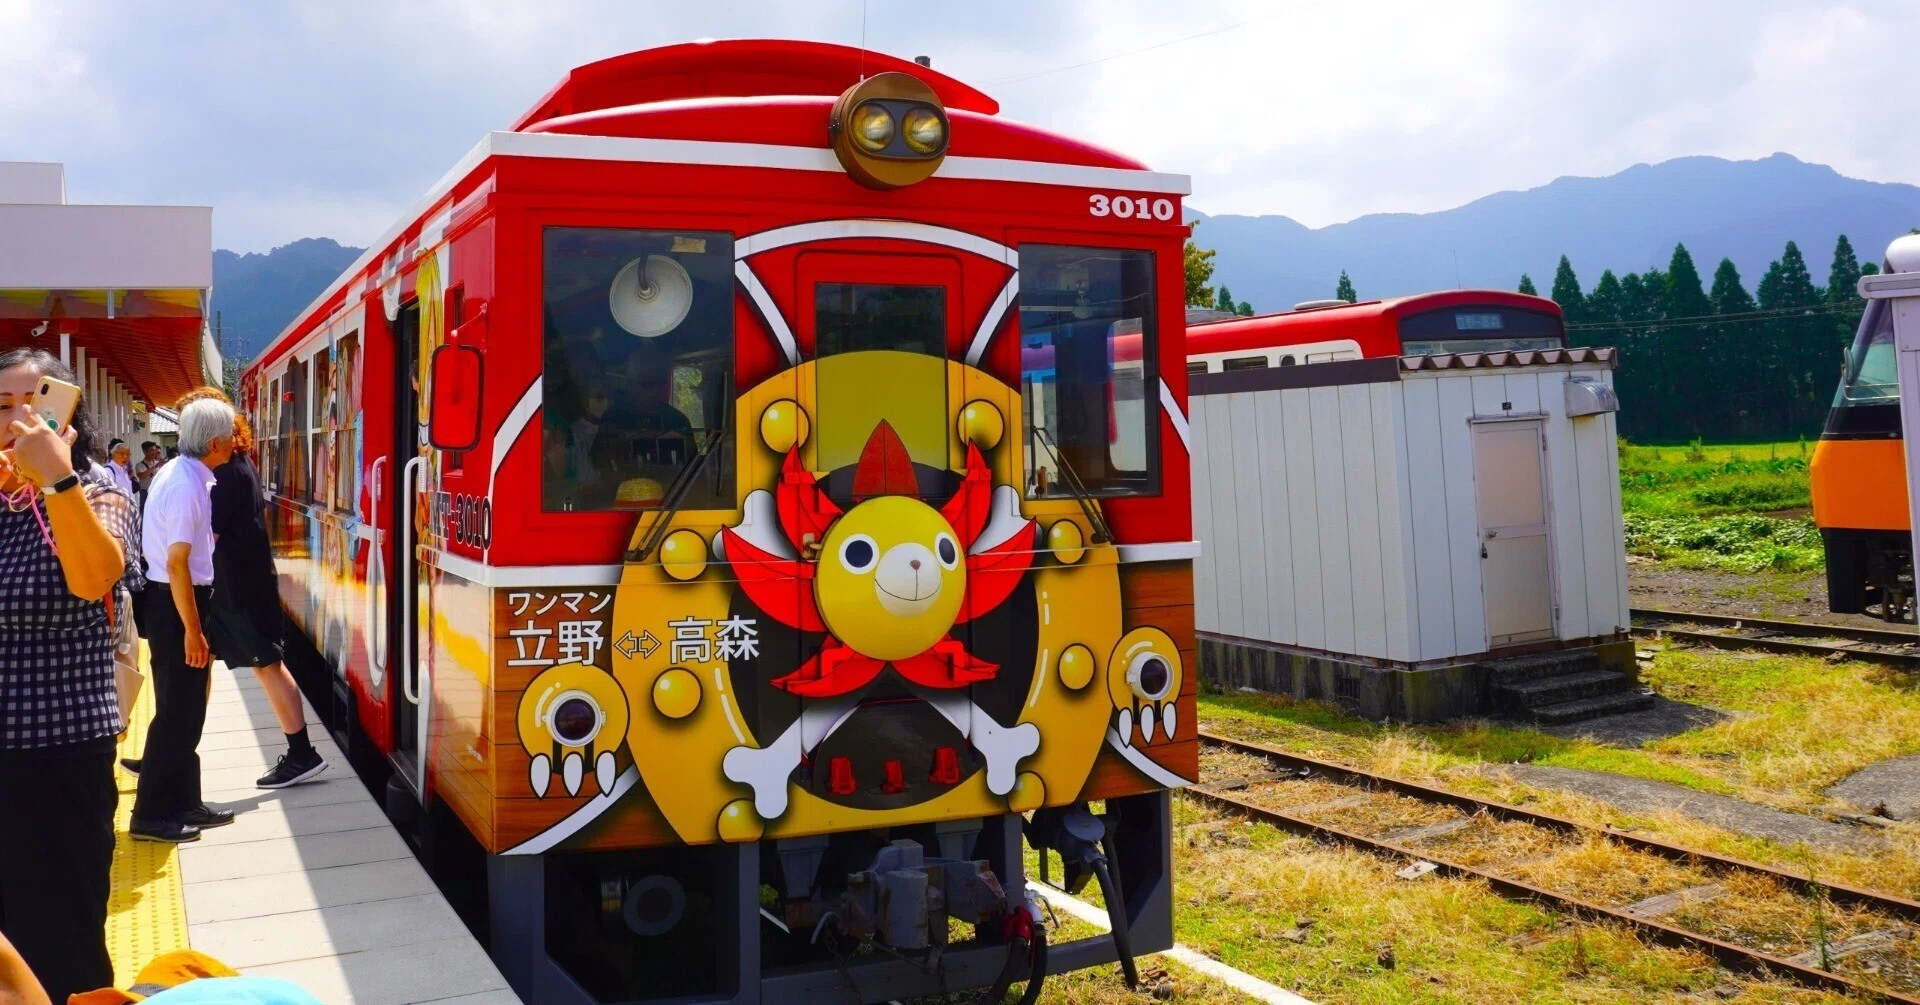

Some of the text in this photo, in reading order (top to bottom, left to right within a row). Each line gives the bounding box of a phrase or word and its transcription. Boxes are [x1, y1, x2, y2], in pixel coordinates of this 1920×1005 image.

[1089, 194, 1174, 221] 3010
[508, 591, 612, 616] ワンマン
[507, 615, 760, 666] 立野 高森
